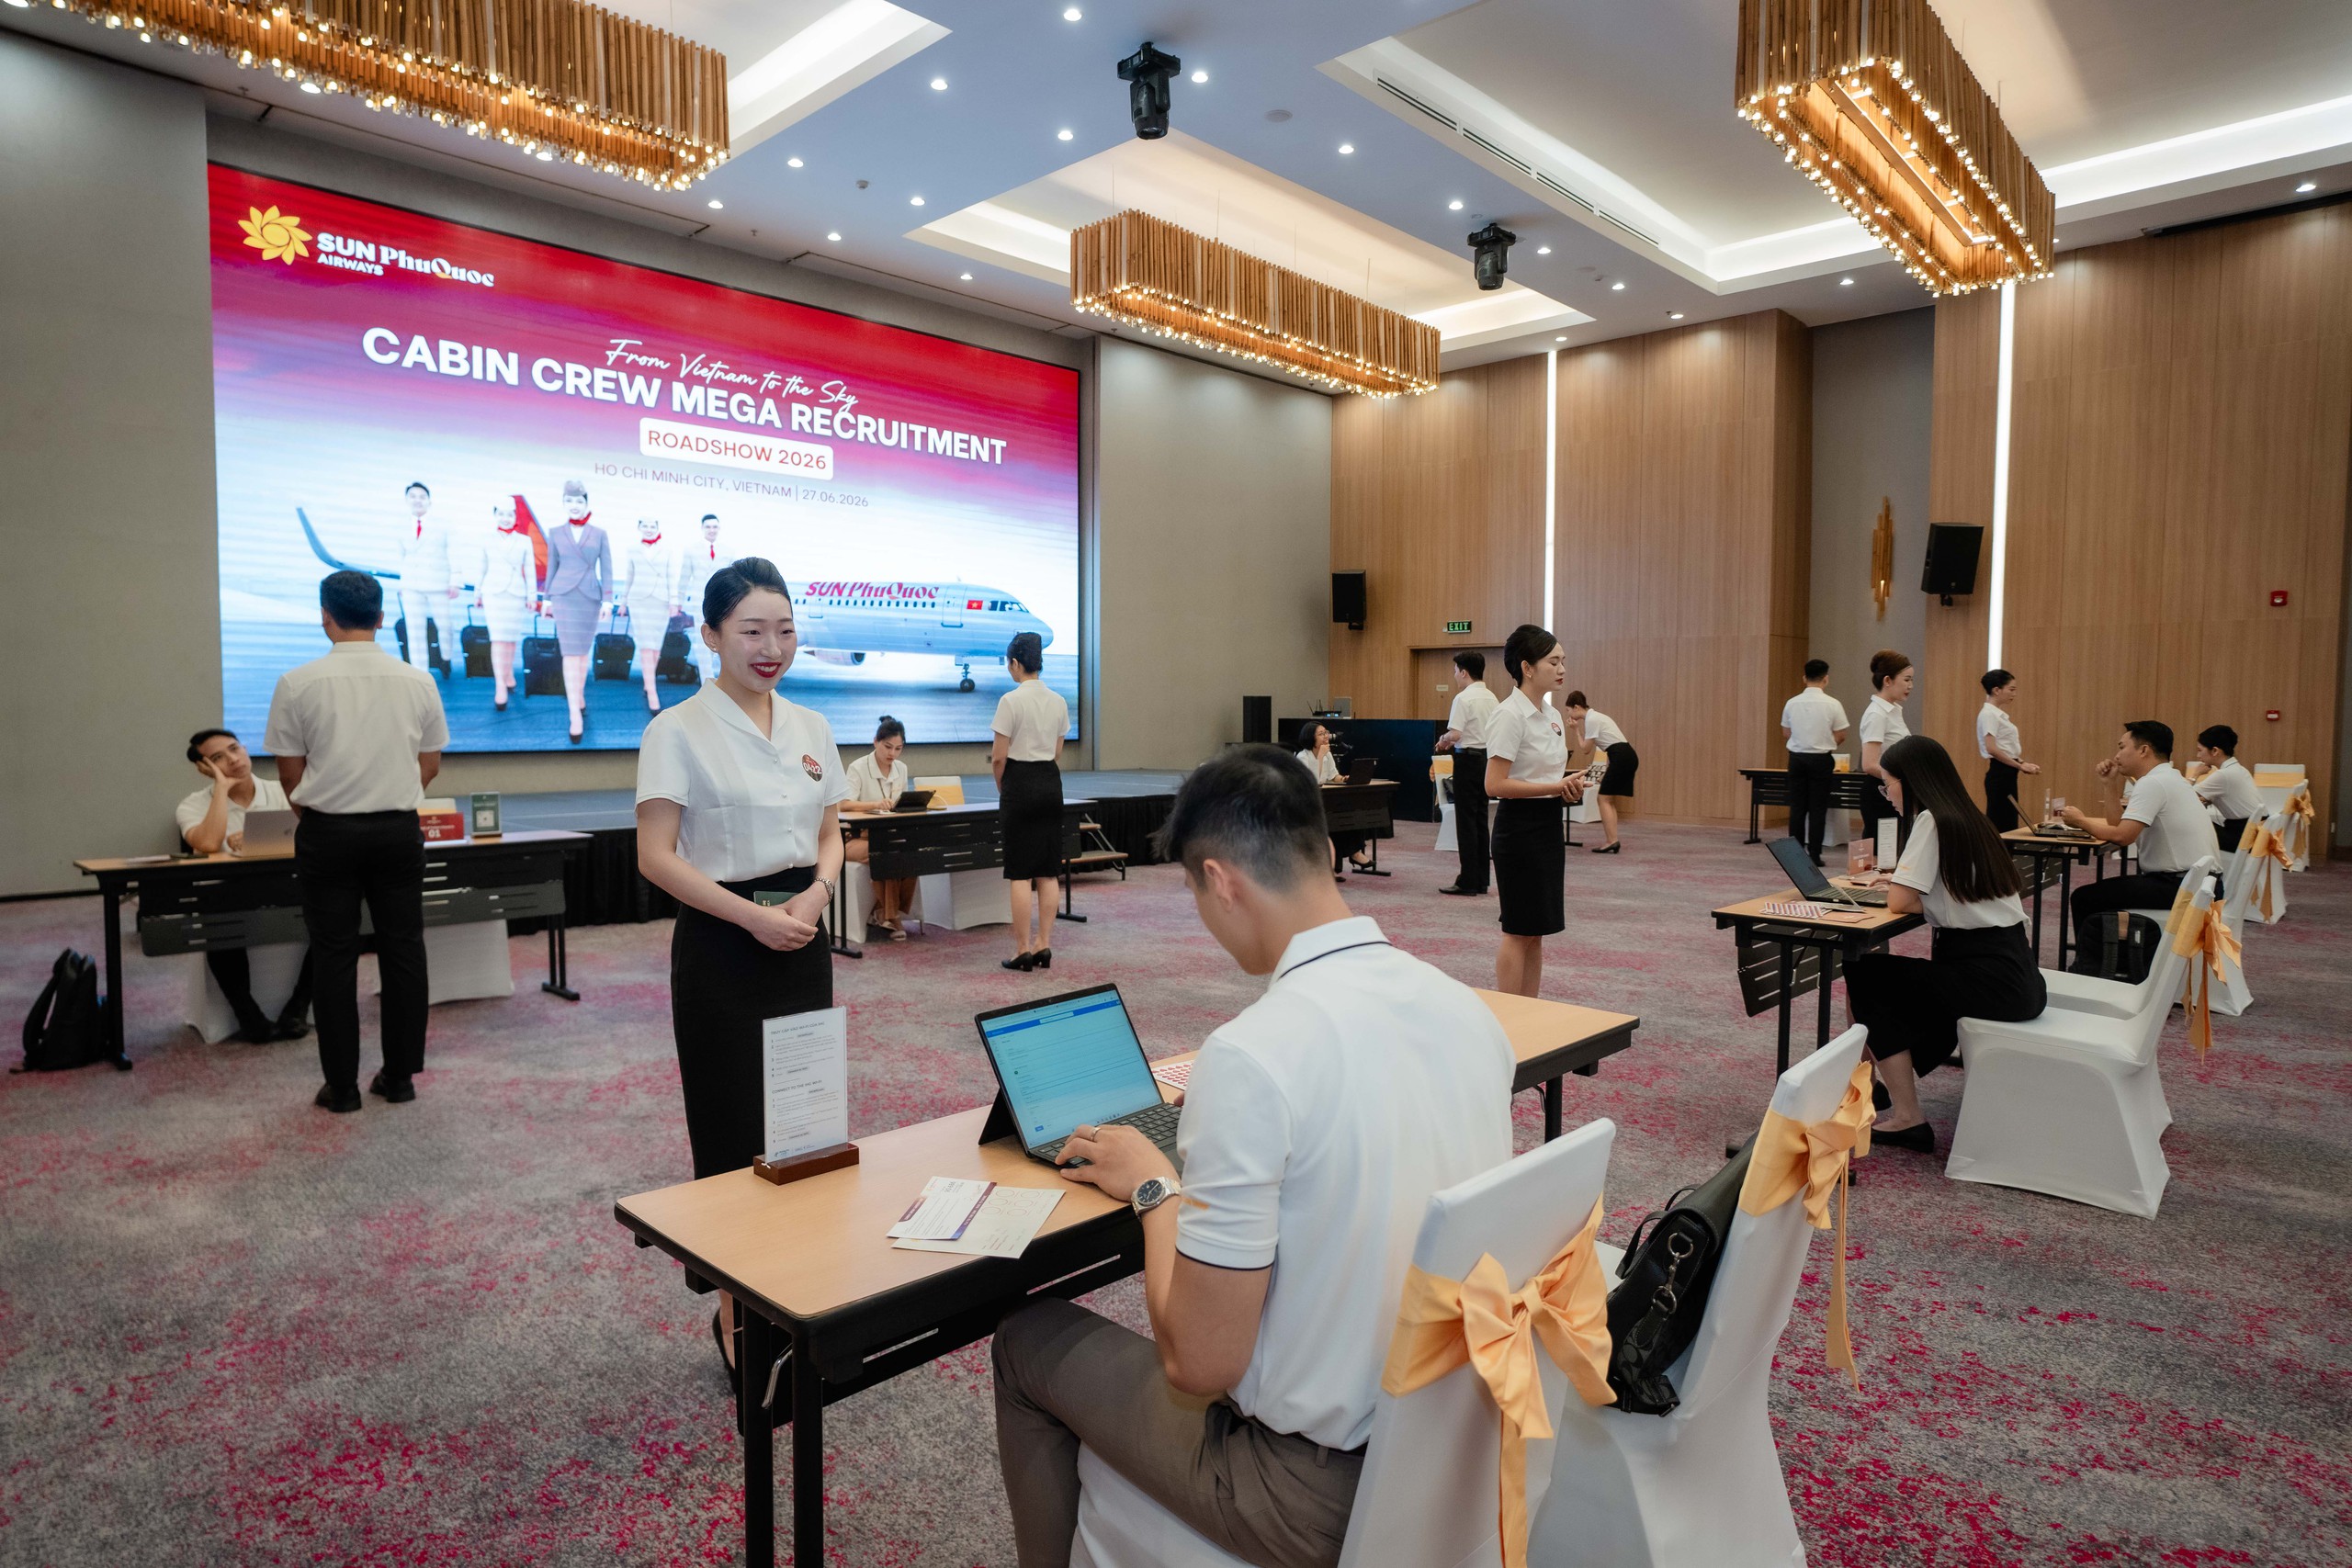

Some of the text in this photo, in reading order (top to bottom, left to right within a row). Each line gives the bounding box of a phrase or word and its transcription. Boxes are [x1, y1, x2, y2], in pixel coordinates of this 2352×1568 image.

[317, 231, 495, 287] SUN PhuQuoc
[317, 254, 384, 276] AIRWAYS
[362, 327, 1007, 465] CABIN CREW MEGA RECRUITMENT
[605, 339, 858, 414] From Vietnam to the Sky
[648, 430, 827, 470] ROADSHOW 2026
[594, 462, 868, 508] HO CHI MINH CITY, VIETNAM 27.06.2026
[805, 581, 939, 600] SUN PhuQuoc
[1448, 622, 1469, 631] EXIT
